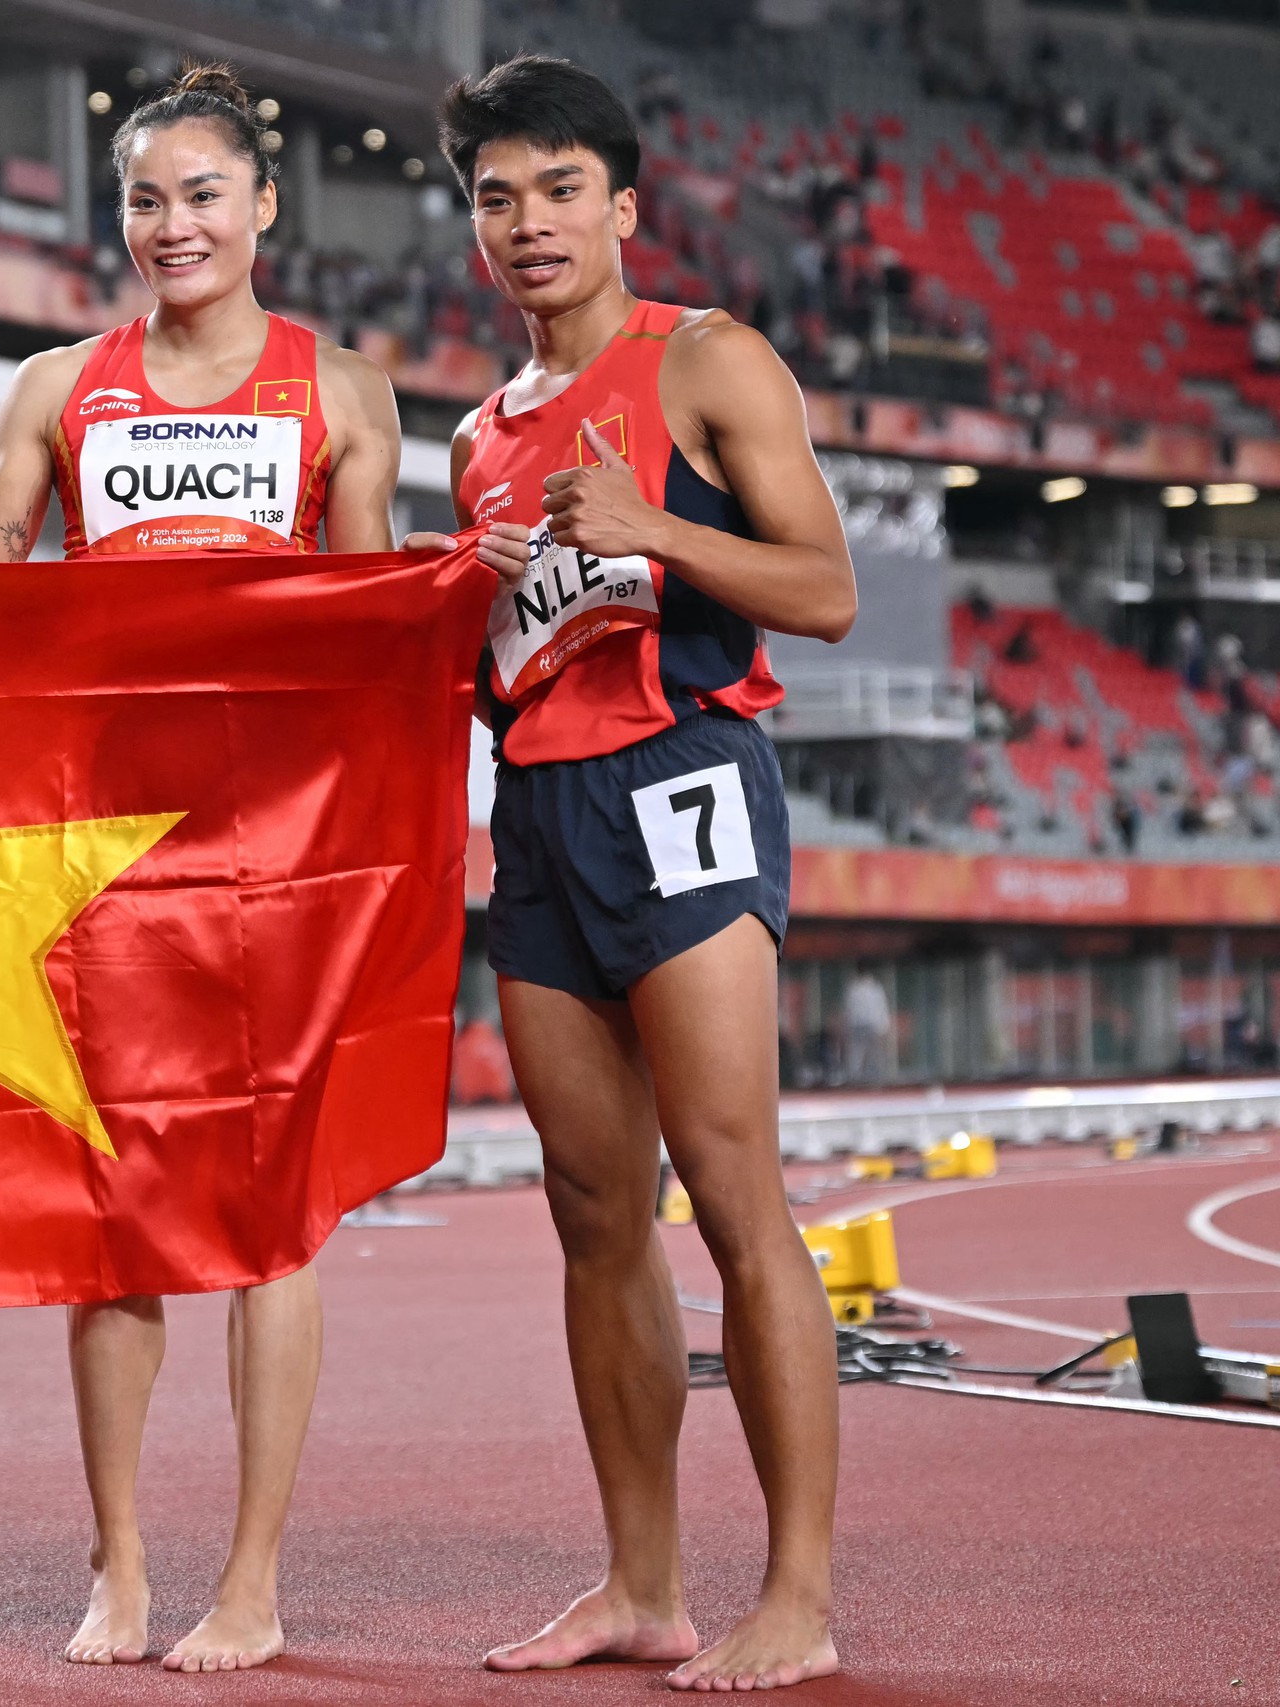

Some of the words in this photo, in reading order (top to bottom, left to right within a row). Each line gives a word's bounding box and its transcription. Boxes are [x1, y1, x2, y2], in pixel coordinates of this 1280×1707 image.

[79, 402, 141, 415] LI-NING
[127, 422, 258, 441] BORNAN
[130, 442, 174, 451] SPORTS
[179, 441, 256, 451] TECHNOLOGY
[104, 462, 277, 511] QUACH
[250, 509, 284, 523] 1138
[152, 528, 170, 536] 20th
[194, 527, 221, 535] Games
[152, 535, 220, 546] Aichi-Nagoya
[222, 534, 248, 543] 2026
[523, 558, 546, 578] ORTS
[513, 550, 606, 636] N.LE
[604, 579, 639, 602] 787
[590, 619, 610, 636] 2026
[668, 783, 718, 872] 7
